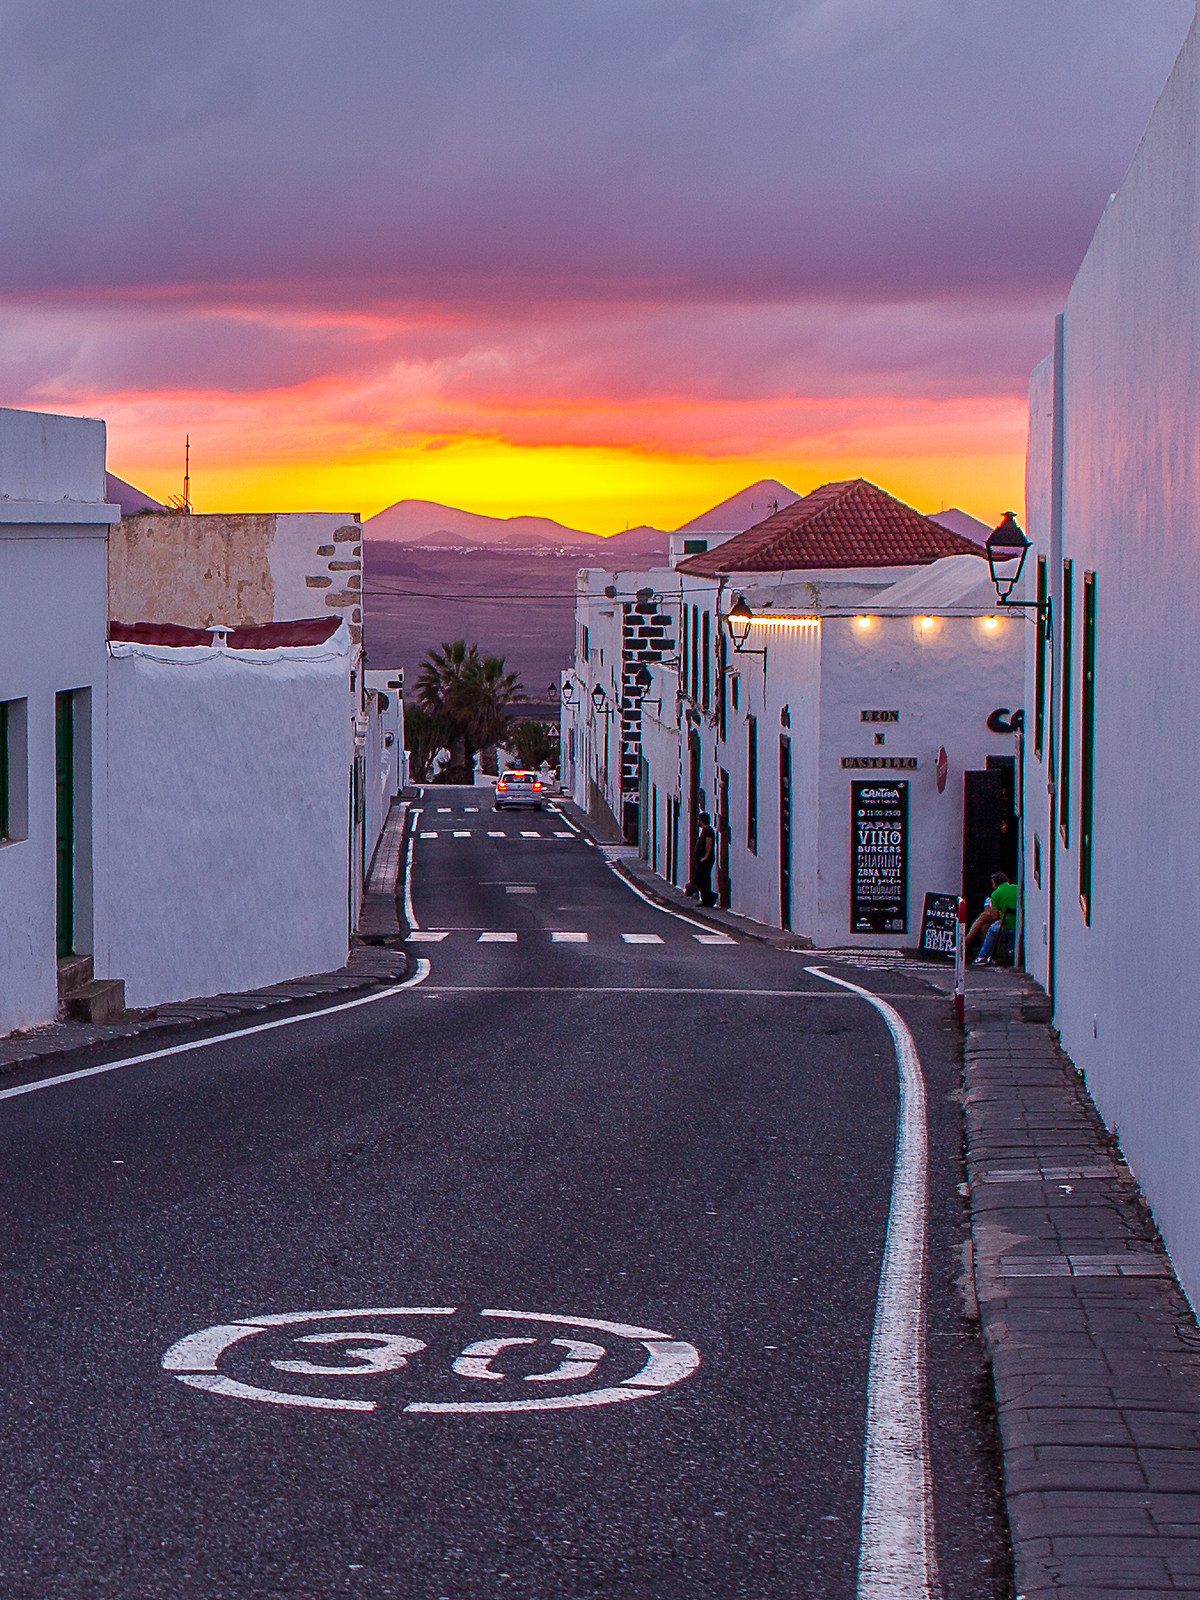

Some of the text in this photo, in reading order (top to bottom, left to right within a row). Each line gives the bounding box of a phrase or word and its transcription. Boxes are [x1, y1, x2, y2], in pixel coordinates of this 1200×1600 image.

[861, 711, 899, 721] LEON
[874, 733, 884, 744] Y
[841, 757, 917, 769] CASTILLO
[858, 821, 902, 830] TAPAS
[858, 830, 902, 845] VINO
[857, 854, 902, 868] SHARING
[857, 868, 901, 877] ZONA WIFI
[856, 885, 902, 895] RESTAURANTE
[925, 928, 955, 943] CRAFT
[924, 937, 956, 952] BEER
[271, 1332, 607, 1381] 30
